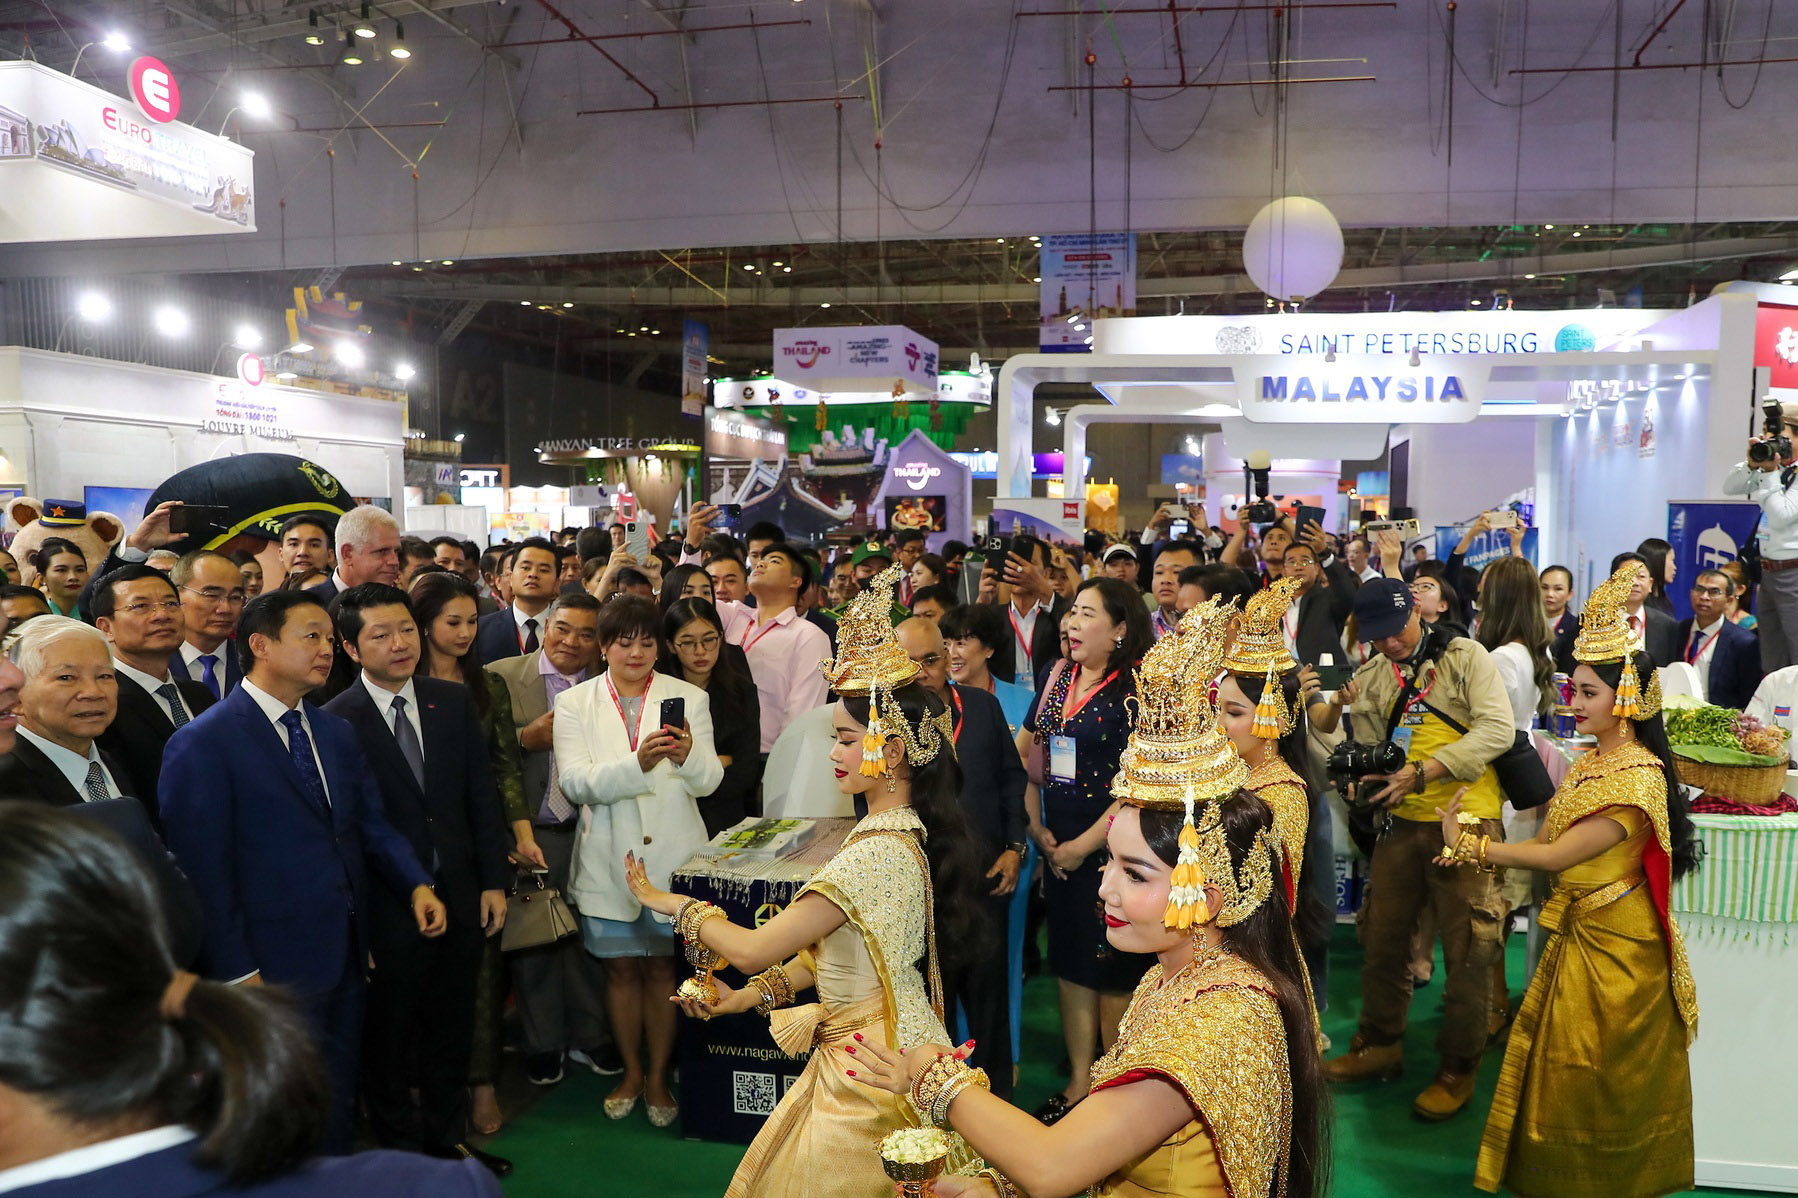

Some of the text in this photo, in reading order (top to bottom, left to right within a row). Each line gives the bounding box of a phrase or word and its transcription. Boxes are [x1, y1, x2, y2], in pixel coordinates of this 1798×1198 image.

[102, 106, 152, 143] EURO
[1281, 332, 1538, 354] SAINT PETERSBURG
[783, 346, 831, 356] THAILAND
[1259, 376, 1464, 402] MALAYSIA
[202, 420, 245, 435] LOUVRE
[597, 437, 633, 450] TREE
[893, 467, 941, 478] THAILAND
